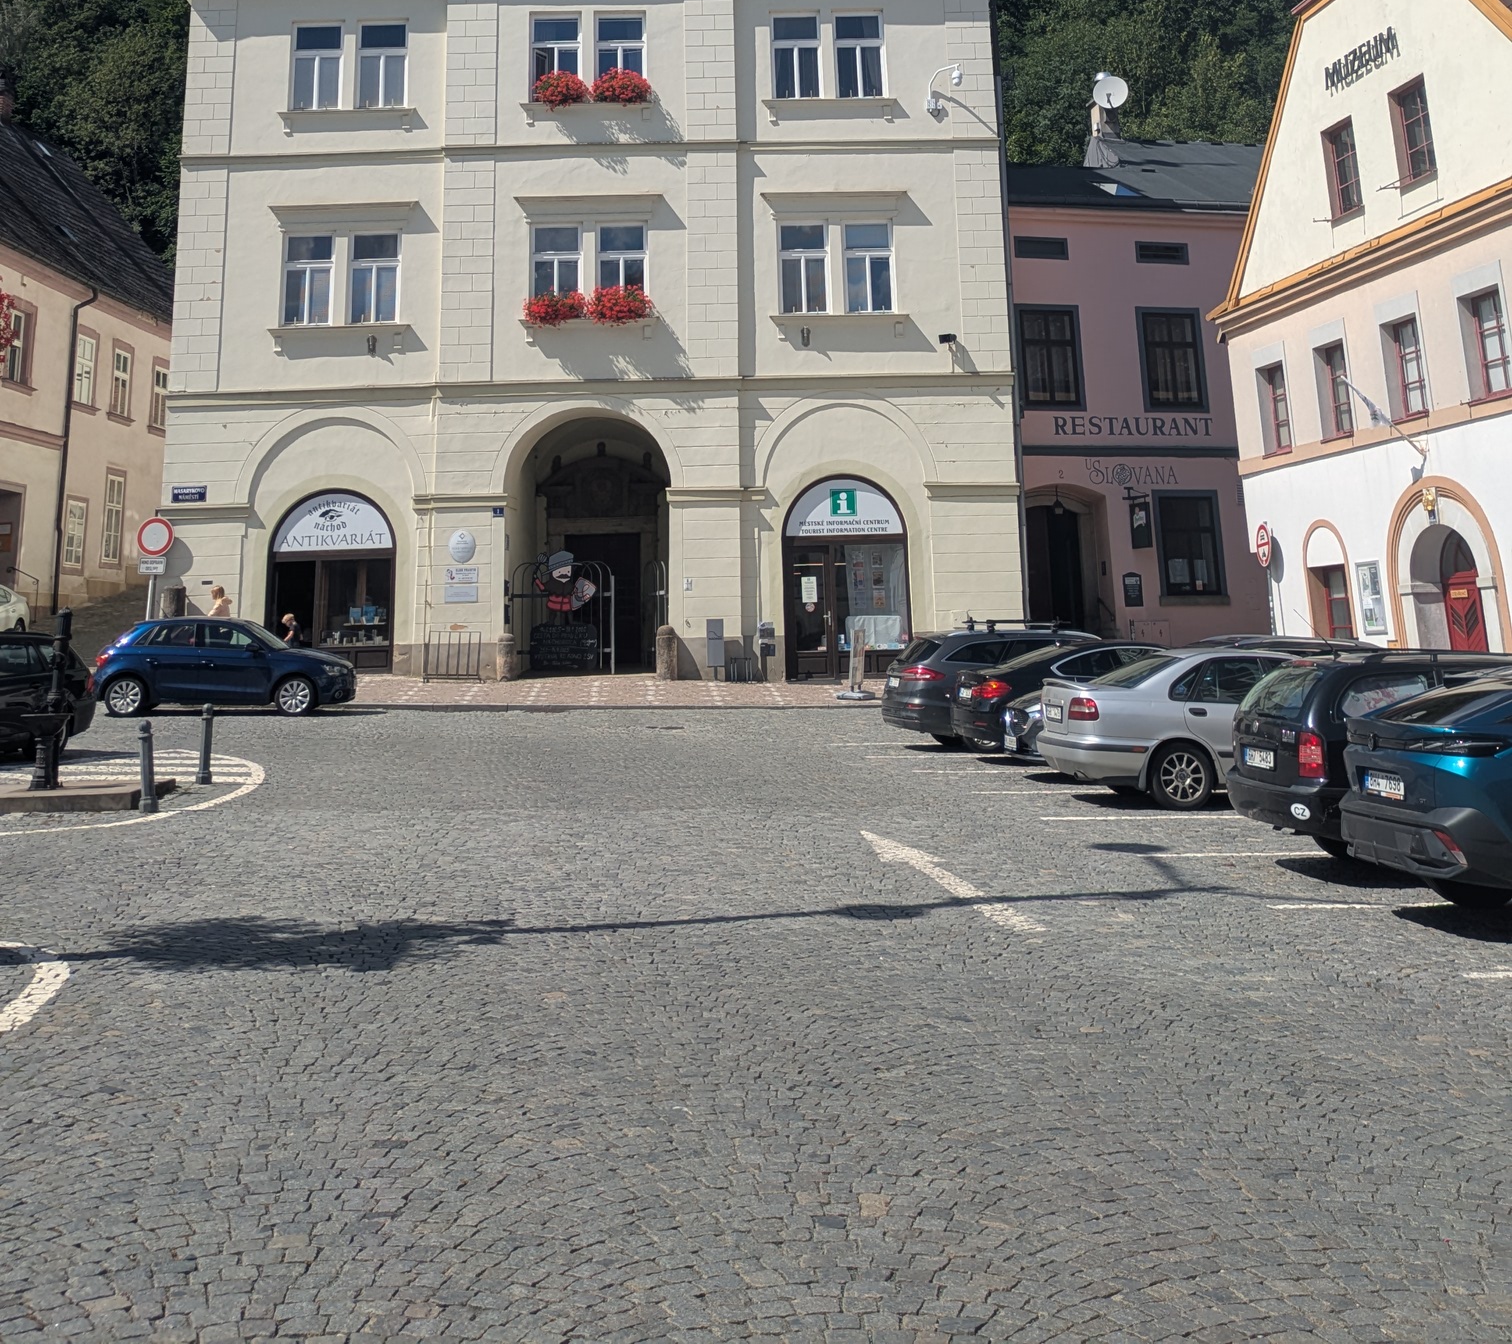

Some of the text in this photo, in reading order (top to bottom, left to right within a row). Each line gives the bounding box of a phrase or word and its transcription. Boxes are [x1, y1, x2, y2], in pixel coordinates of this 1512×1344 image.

[1324, 26, 1395, 91] MUZEUM
[1053, 416, 1213, 437] RESTAURANT
[1085, 459, 1092, 470] U
[1058, 470, 1065, 479] 2
[307, 500, 361, 516] antikvariát
[314, 520, 347, 532] náchod
[279, 530, 386, 548] ANTIKVARIÁT
[1384, 775, 1401, 792] 7698
[1293, 806, 1307, 817] CZ
